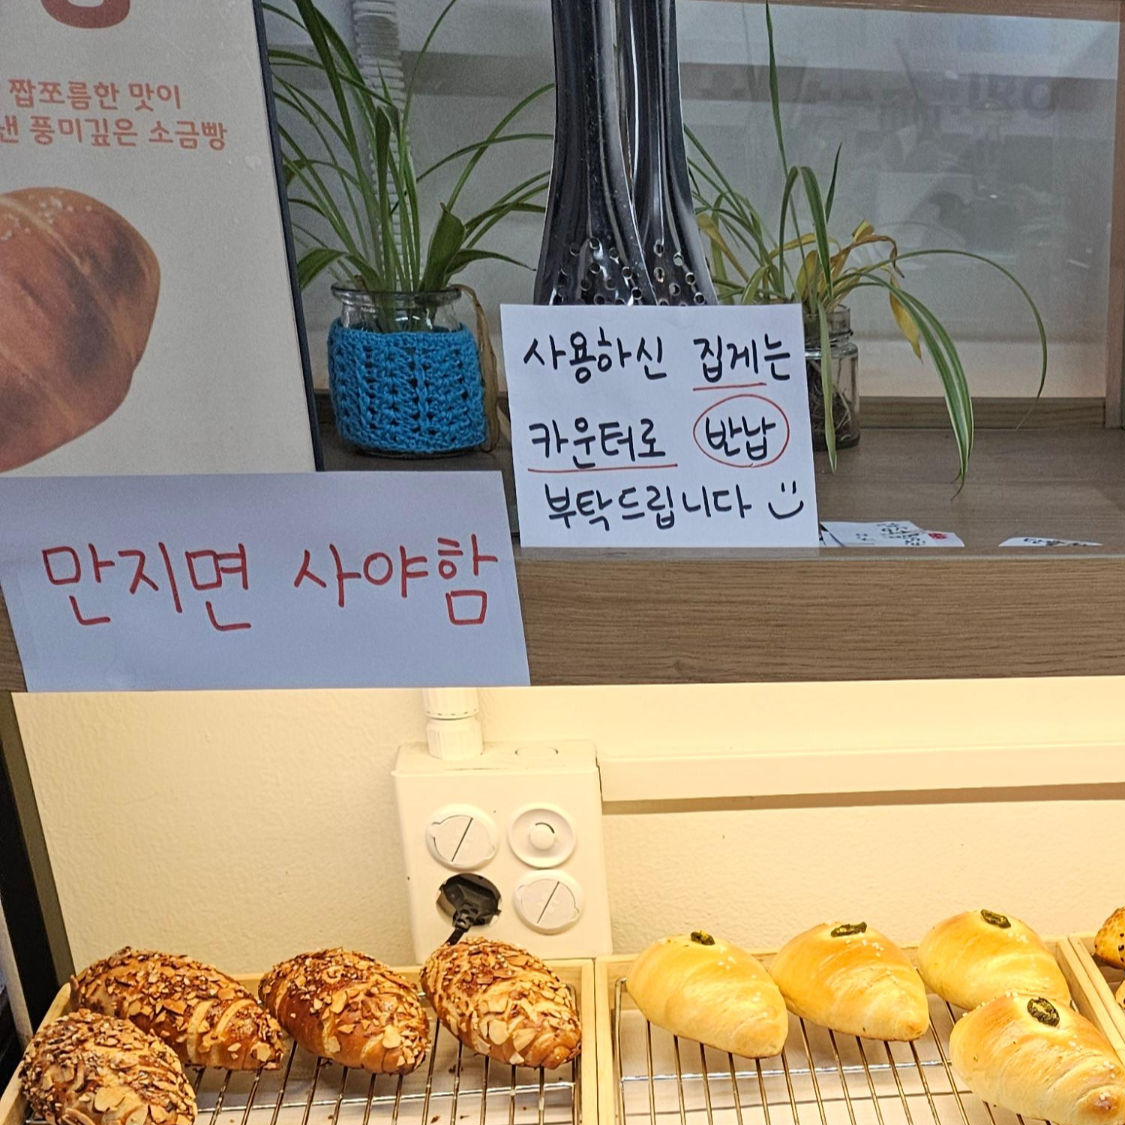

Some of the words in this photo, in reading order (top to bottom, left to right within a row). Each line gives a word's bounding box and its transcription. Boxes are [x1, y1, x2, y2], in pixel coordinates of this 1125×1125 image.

[8, 78, 119, 111] 짭쪼름한
[128, 82, 181, 112] 맛이
[149, 119, 228, 151] 소금빵
[523, 326, 667, 384] 사용하신
[693, 334, 791, 383] 집게는
[528, 417, 666, 469] 카운터로
[705, 416, 776, 461] 반납
[544, 483, 752, 531] 부탁드립니다
[42, 541, 253, 632] 만지면
[293, 534, 500, 626] 사야함
